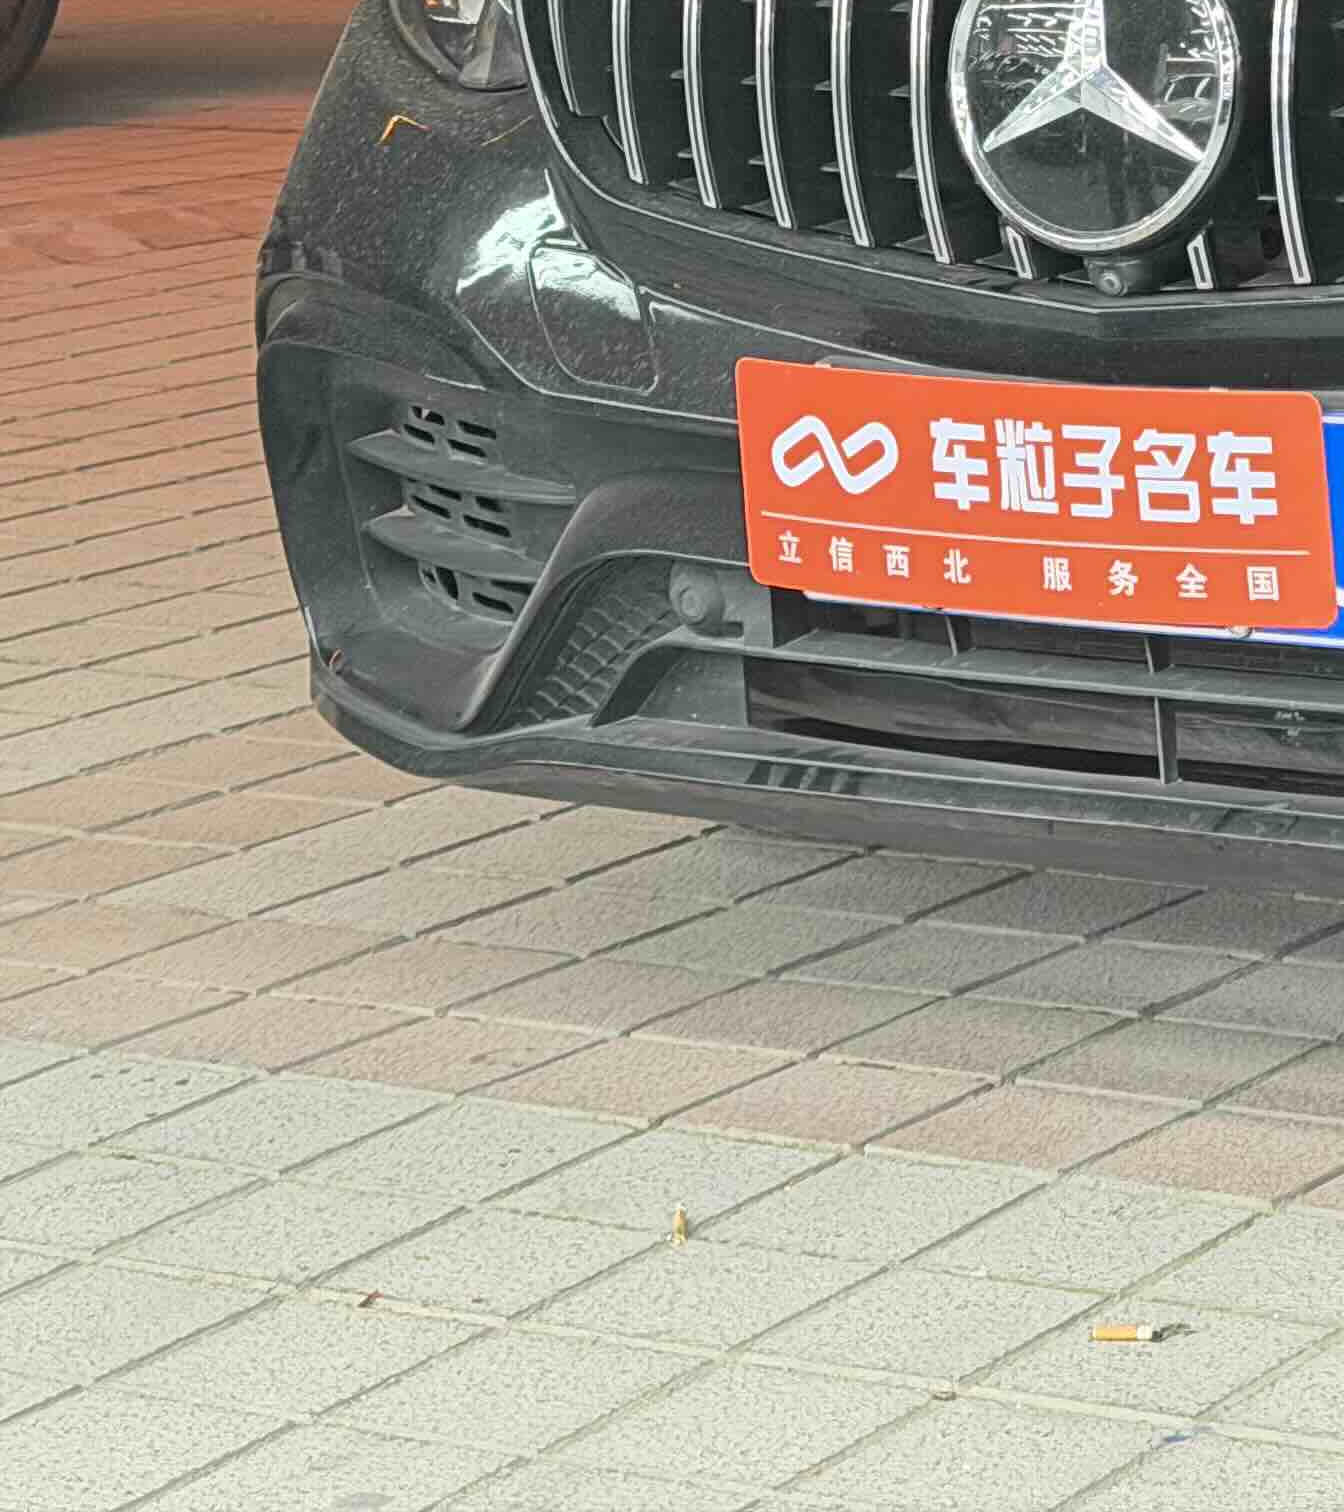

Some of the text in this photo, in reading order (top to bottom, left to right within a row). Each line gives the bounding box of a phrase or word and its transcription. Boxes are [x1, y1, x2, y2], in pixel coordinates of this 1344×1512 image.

[930, 417, 1279, 525] 车粒子名车
[778, 529, 1280, 601] 立信西北 服务全国
